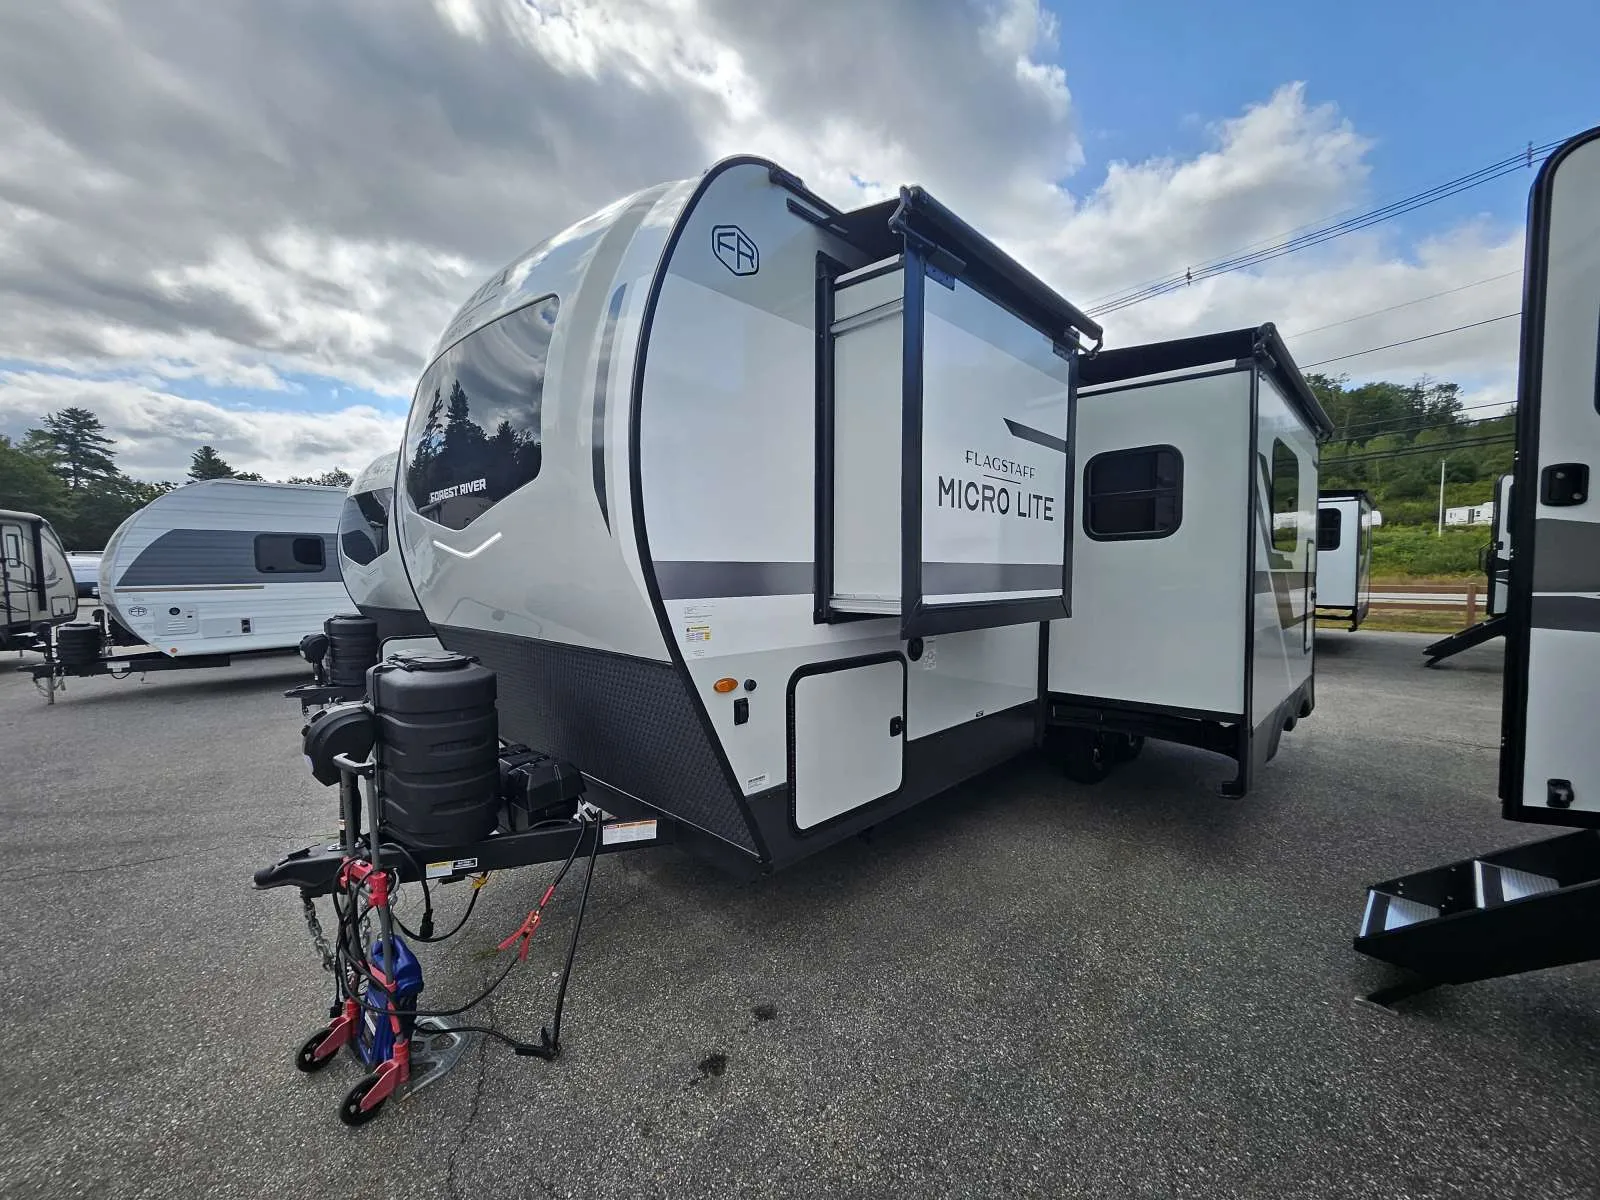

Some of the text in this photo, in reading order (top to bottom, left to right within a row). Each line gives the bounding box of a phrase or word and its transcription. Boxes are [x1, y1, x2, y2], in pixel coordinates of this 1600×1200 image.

[965, 450, 1035, 478] FLAGSTAFF
[430, 478, 487, 502] FOREST RIVER
[938, 476, 1054, 521] MICRO LITE
